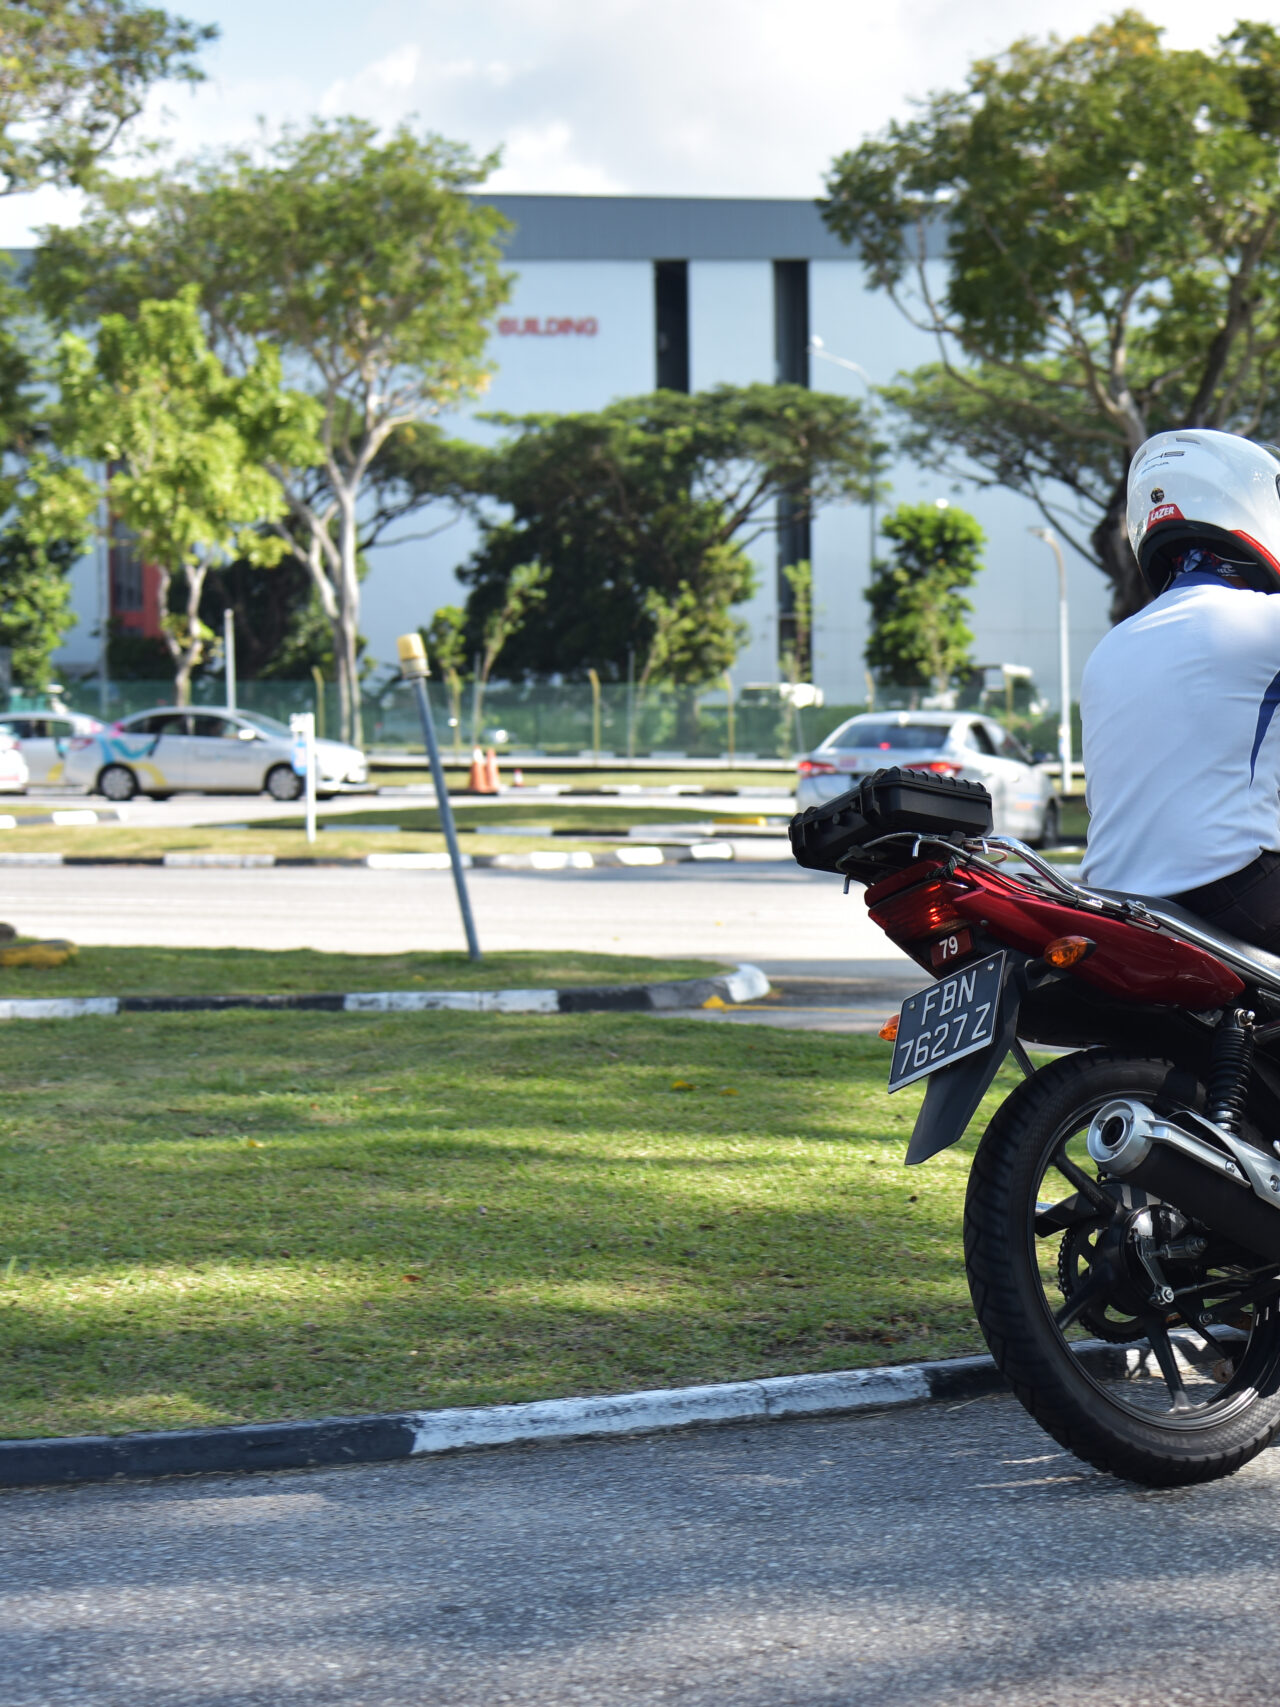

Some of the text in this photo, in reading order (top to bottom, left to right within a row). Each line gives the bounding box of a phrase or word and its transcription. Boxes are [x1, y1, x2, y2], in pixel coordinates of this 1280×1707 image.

[498, 317, 598, 337] BUILDING
[1151, 506, 1175, 521] LAZER
[939, 936, 958, 959] 79
[921, 970, 976, 1026] FBN
[900, 1002, 991, 1075] 7627Z
